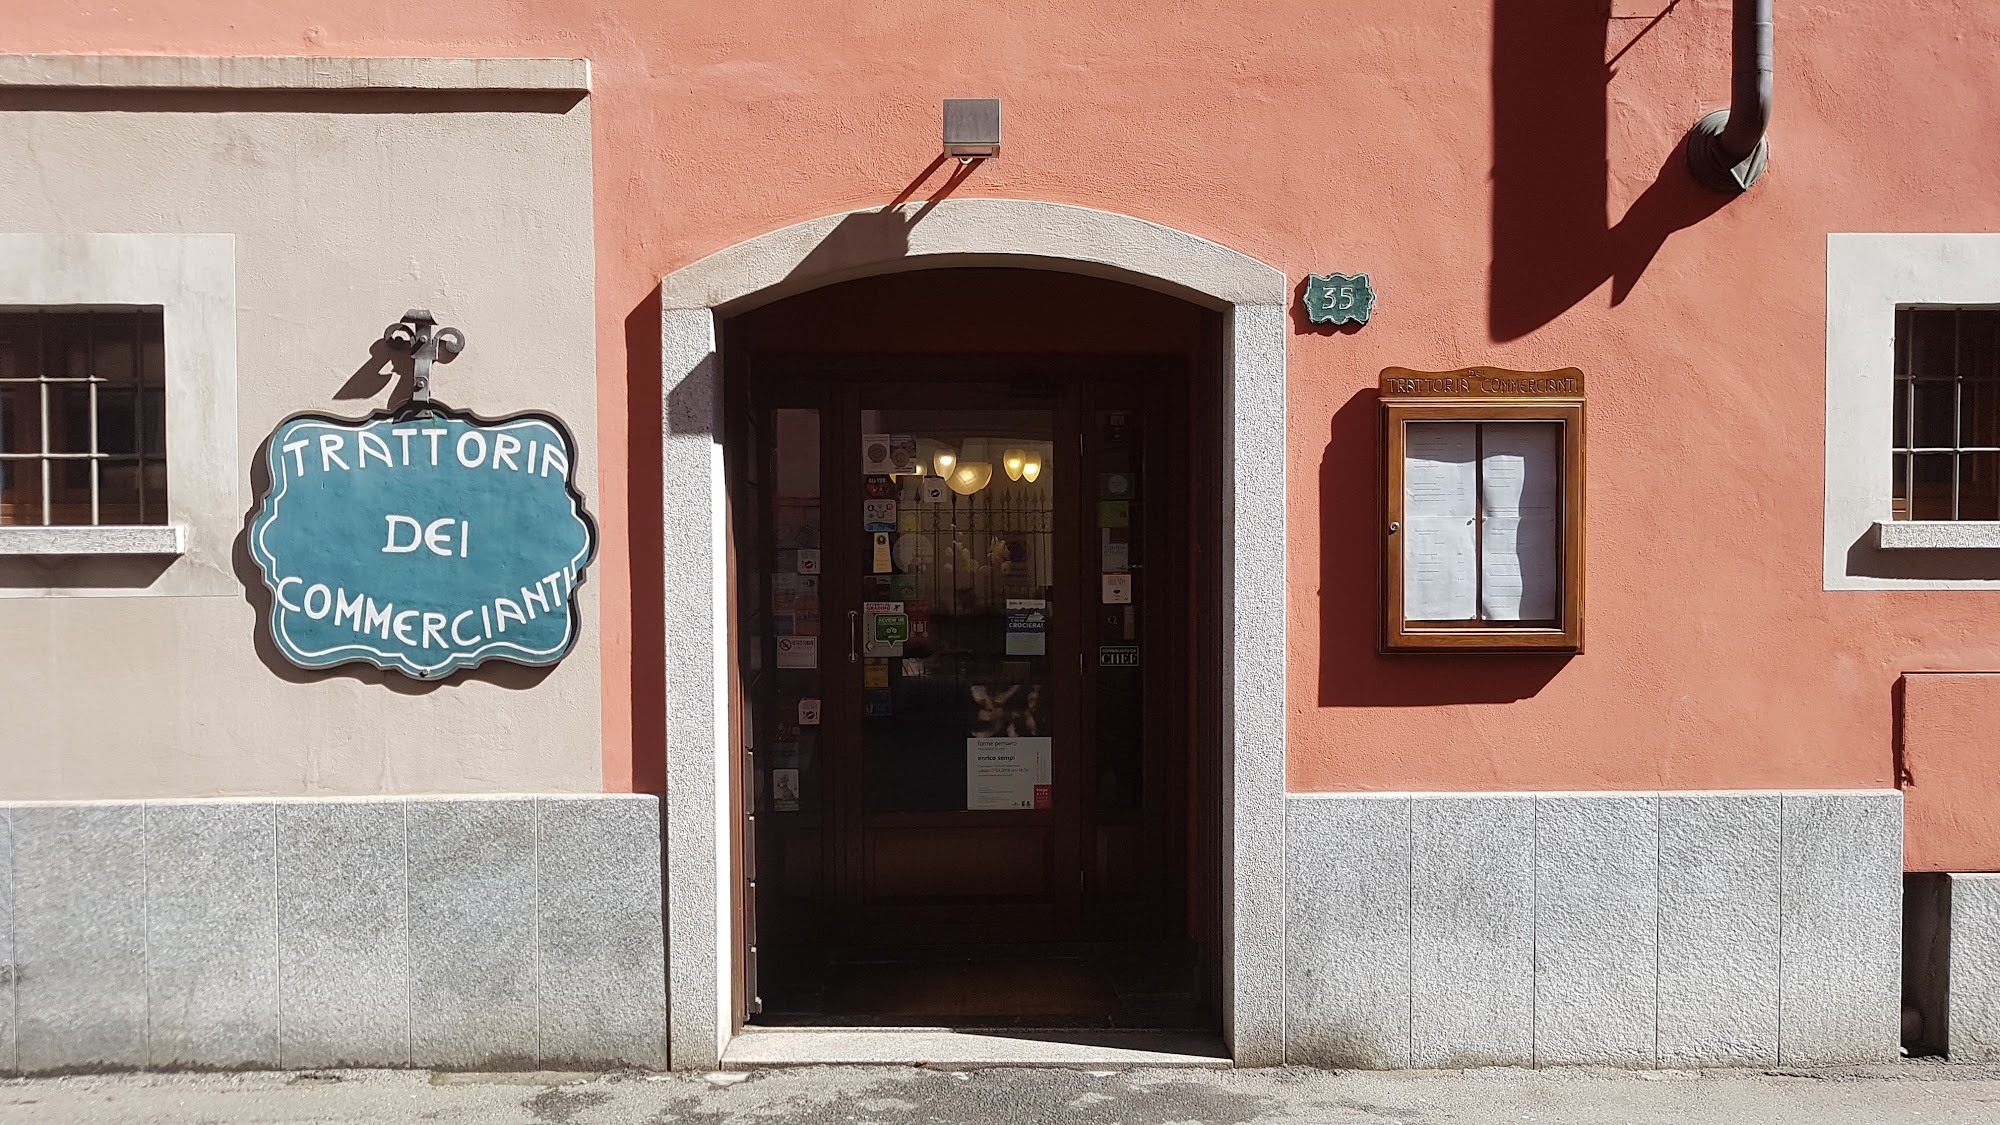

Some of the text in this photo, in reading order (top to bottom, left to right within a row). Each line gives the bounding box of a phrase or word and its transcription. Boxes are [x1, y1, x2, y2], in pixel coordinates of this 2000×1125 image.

[1321, 286, 1354, 310] 35
[1387, 377, 1578, 394] TRATTORIA COMMERCIANTI
[1467, 369, 1486, 378] DEI
[283, 428, 569, 482] TRATTORIA
[382, 514, 469, 558] DEI
[277, 566, 572, 649] COMMERCIANTI
[1101, 653, 1138, 664] CHEF
